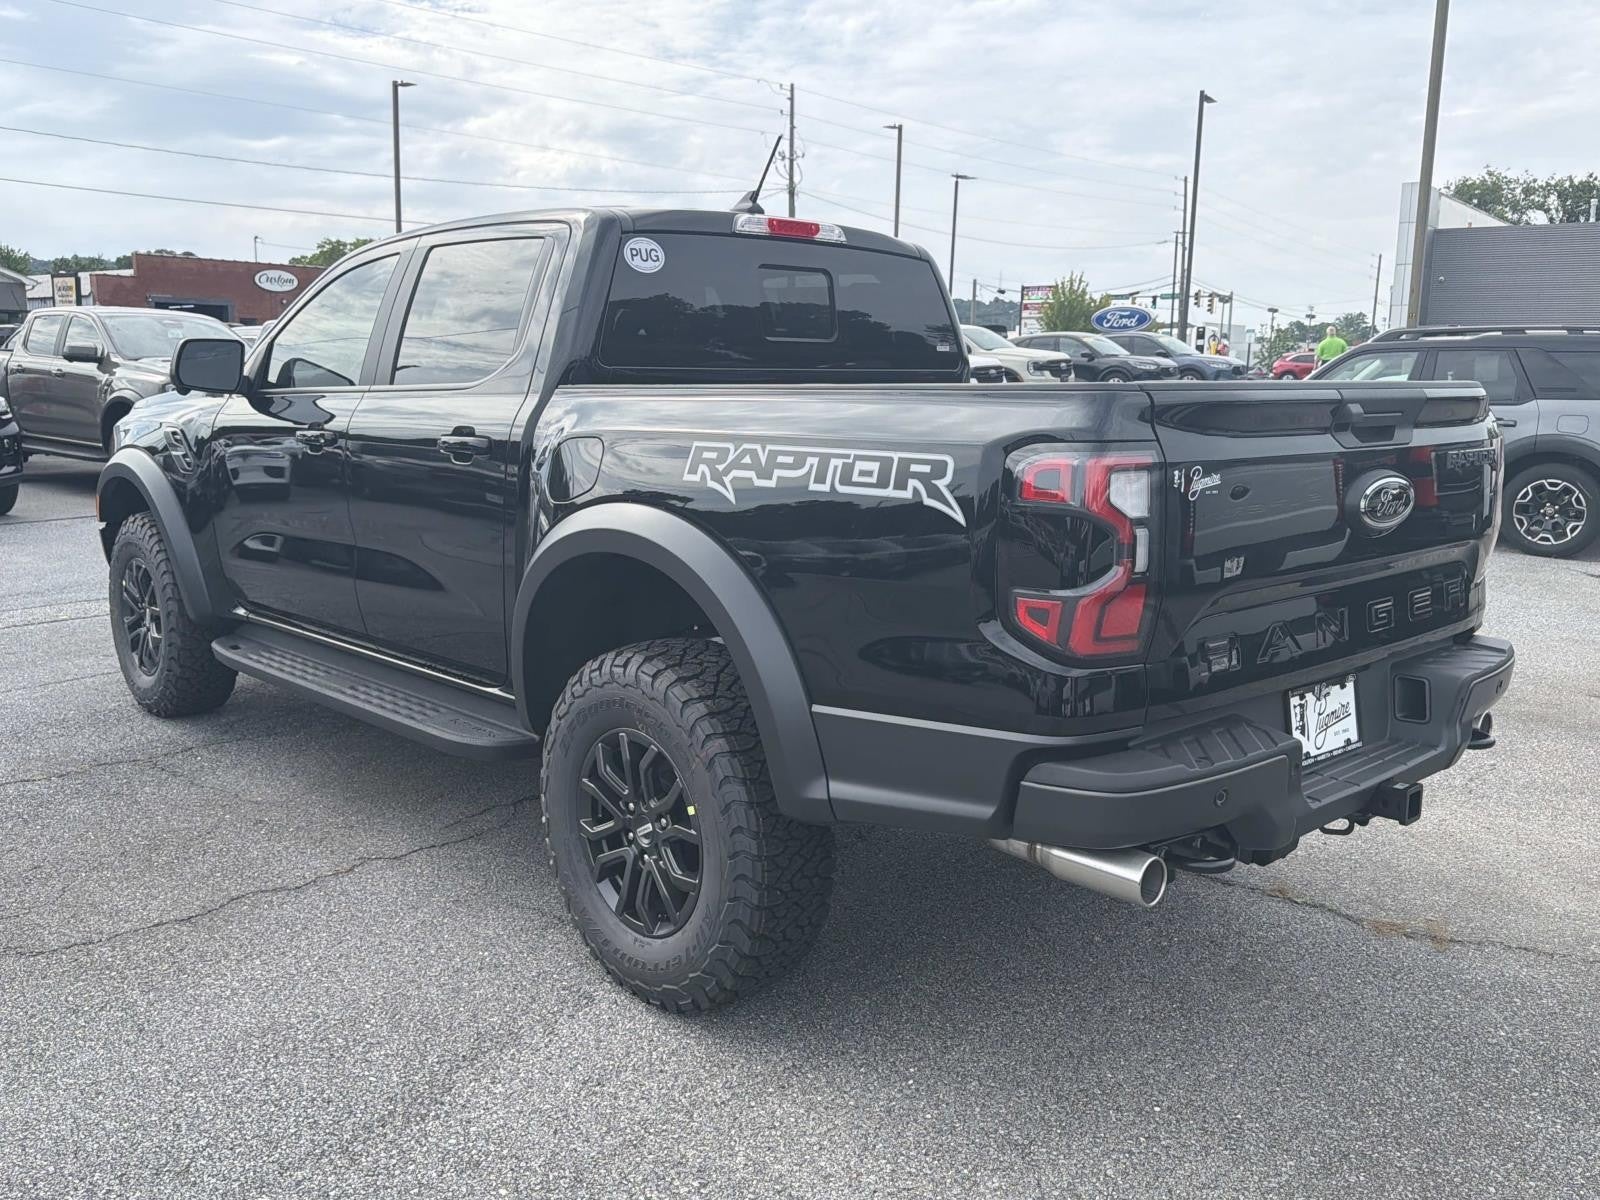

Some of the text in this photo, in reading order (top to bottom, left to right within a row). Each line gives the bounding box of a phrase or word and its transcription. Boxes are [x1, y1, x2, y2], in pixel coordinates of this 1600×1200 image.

[629, 247, 661, 263] PUG
[258, 272, 295, 288] Custom
[1102, 310, 1140, 328] Ford
[683, 441, 966, 528] RAPTOR
[1188, 465, 1221, 501] Pugmire
[1376, 487, 1407, 518] Ford
[1203, 574, 1467, 672] RANGER
[1314, 692, 1352, 751] Pugmire
